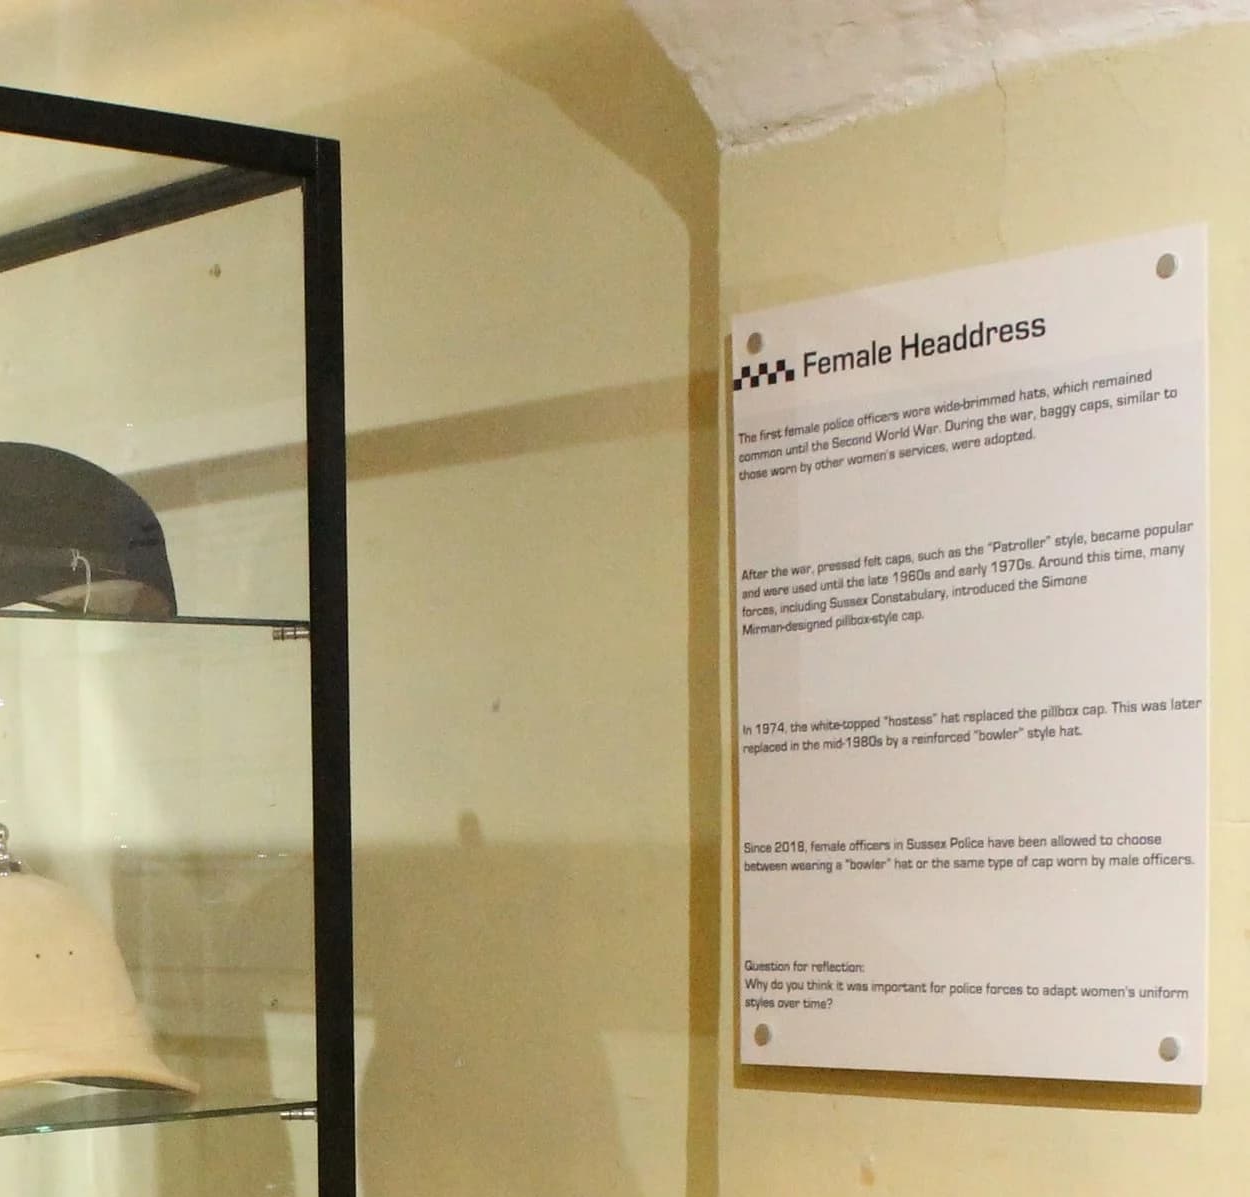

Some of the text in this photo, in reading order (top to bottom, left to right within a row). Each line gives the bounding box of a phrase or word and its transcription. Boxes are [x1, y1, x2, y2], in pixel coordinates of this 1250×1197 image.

[802, 316, 1046, 378] Female Headdress
[737, 367, 1153, 445] The first female police officers wore wide-brimmed hats, which remained
[737, 387, 1178, 464] common until the Second World War. During the war, baggy caps, similar to
[737, 426, 1037, 481] those worn by other women's services, were adopted.
[740, 567, 769, 581] After
[770, 565, 789, 578] the
[789, 564, 815, 576] war,
[816, 556, 862, 576] pressed
[862, 554, 883, 568] felt
[884, 552, 915, 567] caps,
[916, 546, 946, 562] such
[946, 547, 962, 559] as
[963, 543, 984, 557] the
[1053, 531, 1088, 549] style,
[1089, 527, 1141, 543] became
[1142, 519, 1194, 541] popular
[741, 543, 1185, 600] and were used until the late 1960s and early 1970s. Around this time, many
[741, 574, 1087, 618] forces, including Sussex Constabulary, introduced the Simone
[741, 609, 925, 636] Mirman-designed pillbox-style cap.
[741, 723, 752, 736] In
[754, 720, 788, 735] 1974,
[788, 720, 808, 734] the
[809, 715, 881, 733] white-topped
[939, 711, 961, 724] hat
[962, 706, 1015, 725] replaced
[1015, 706, 1038, 720] the
[1039, 704, 1079, 721] pillbox
[1081, 704, 1108, 718] cap.
[1110, 699, 1138, 714] This
[1139, 700, 1167, 712] was
[1169, 696, 1203, 711] later
[741, 739, 788, 756] replaced
[789, 739, 800, 751] in
[800, 738, 821, 751] the
[821, 734, 883, 750] mid-1980s
[884, 734, 899, 749] by
[900, 735, 909, 746] a
[910, 729, 971, 745] reinforced
[1026, 724, 1056, 742] style
[1058, 724, 1083, 737] hat.
[743, 832, 1162, 854] Since 2018, female officers in Sussex Police have been allowed to choose
[743, 859, 788, 872] between
[789, 858, 833, 874] wearing
[834, 860, 843, 871] a
[893, 856, 914, 870] hat
[914, 858, 929, 869] or
[930, 856, 951, 869] the
[952, 858, 985, 869] same
[986, 856, 1014, 871] type
[1015, 854, 1029, 868] of
[1030, 856, 1054, 870] cap
[1055, 856, 1088, 868] worn
[1090, 853, 1106, 870] by
[1108, 852, 1140, 866] male
[1141, 851, 1195, 866] officers.
[743, 958, 865, 973] Question for reflection:
[743, 995, 834, 1011] styles over time?
[744, 976, 1188, 1000] Why do you think it was important for police forces to adapt women's uniform
